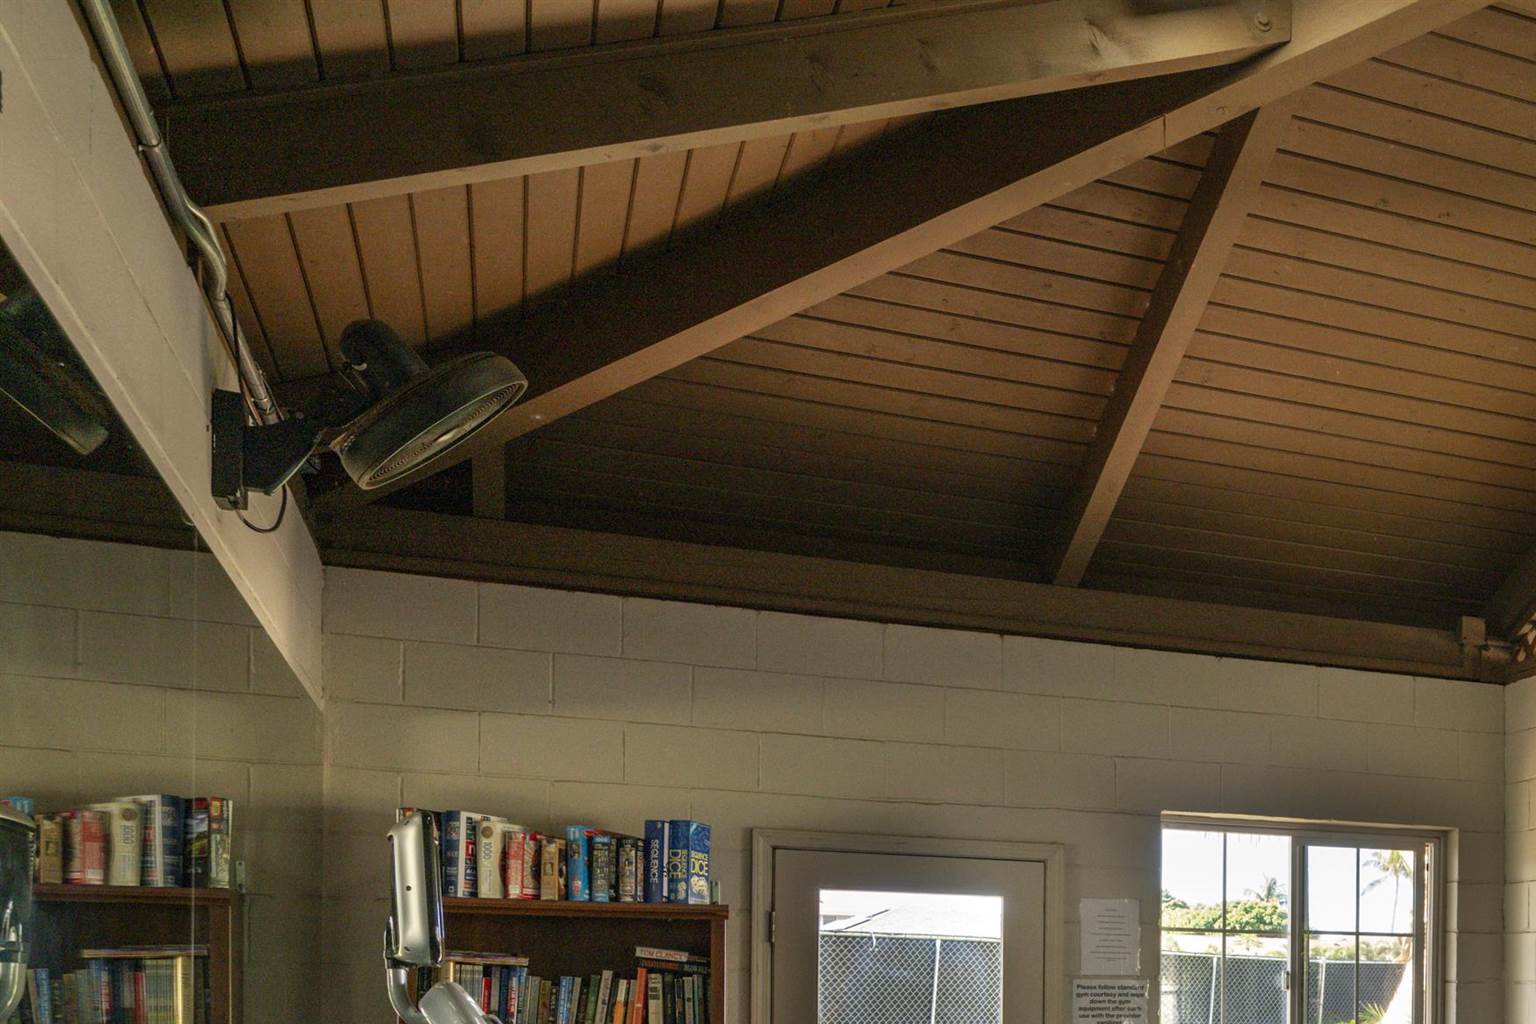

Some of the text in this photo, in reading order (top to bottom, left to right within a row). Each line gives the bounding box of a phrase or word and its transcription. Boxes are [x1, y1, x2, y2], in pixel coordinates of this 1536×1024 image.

[649, 839, 659, 884] SEQUENCE
[670, 849, 681, 879] DICE
[690, 859, 709, 876] DICE
